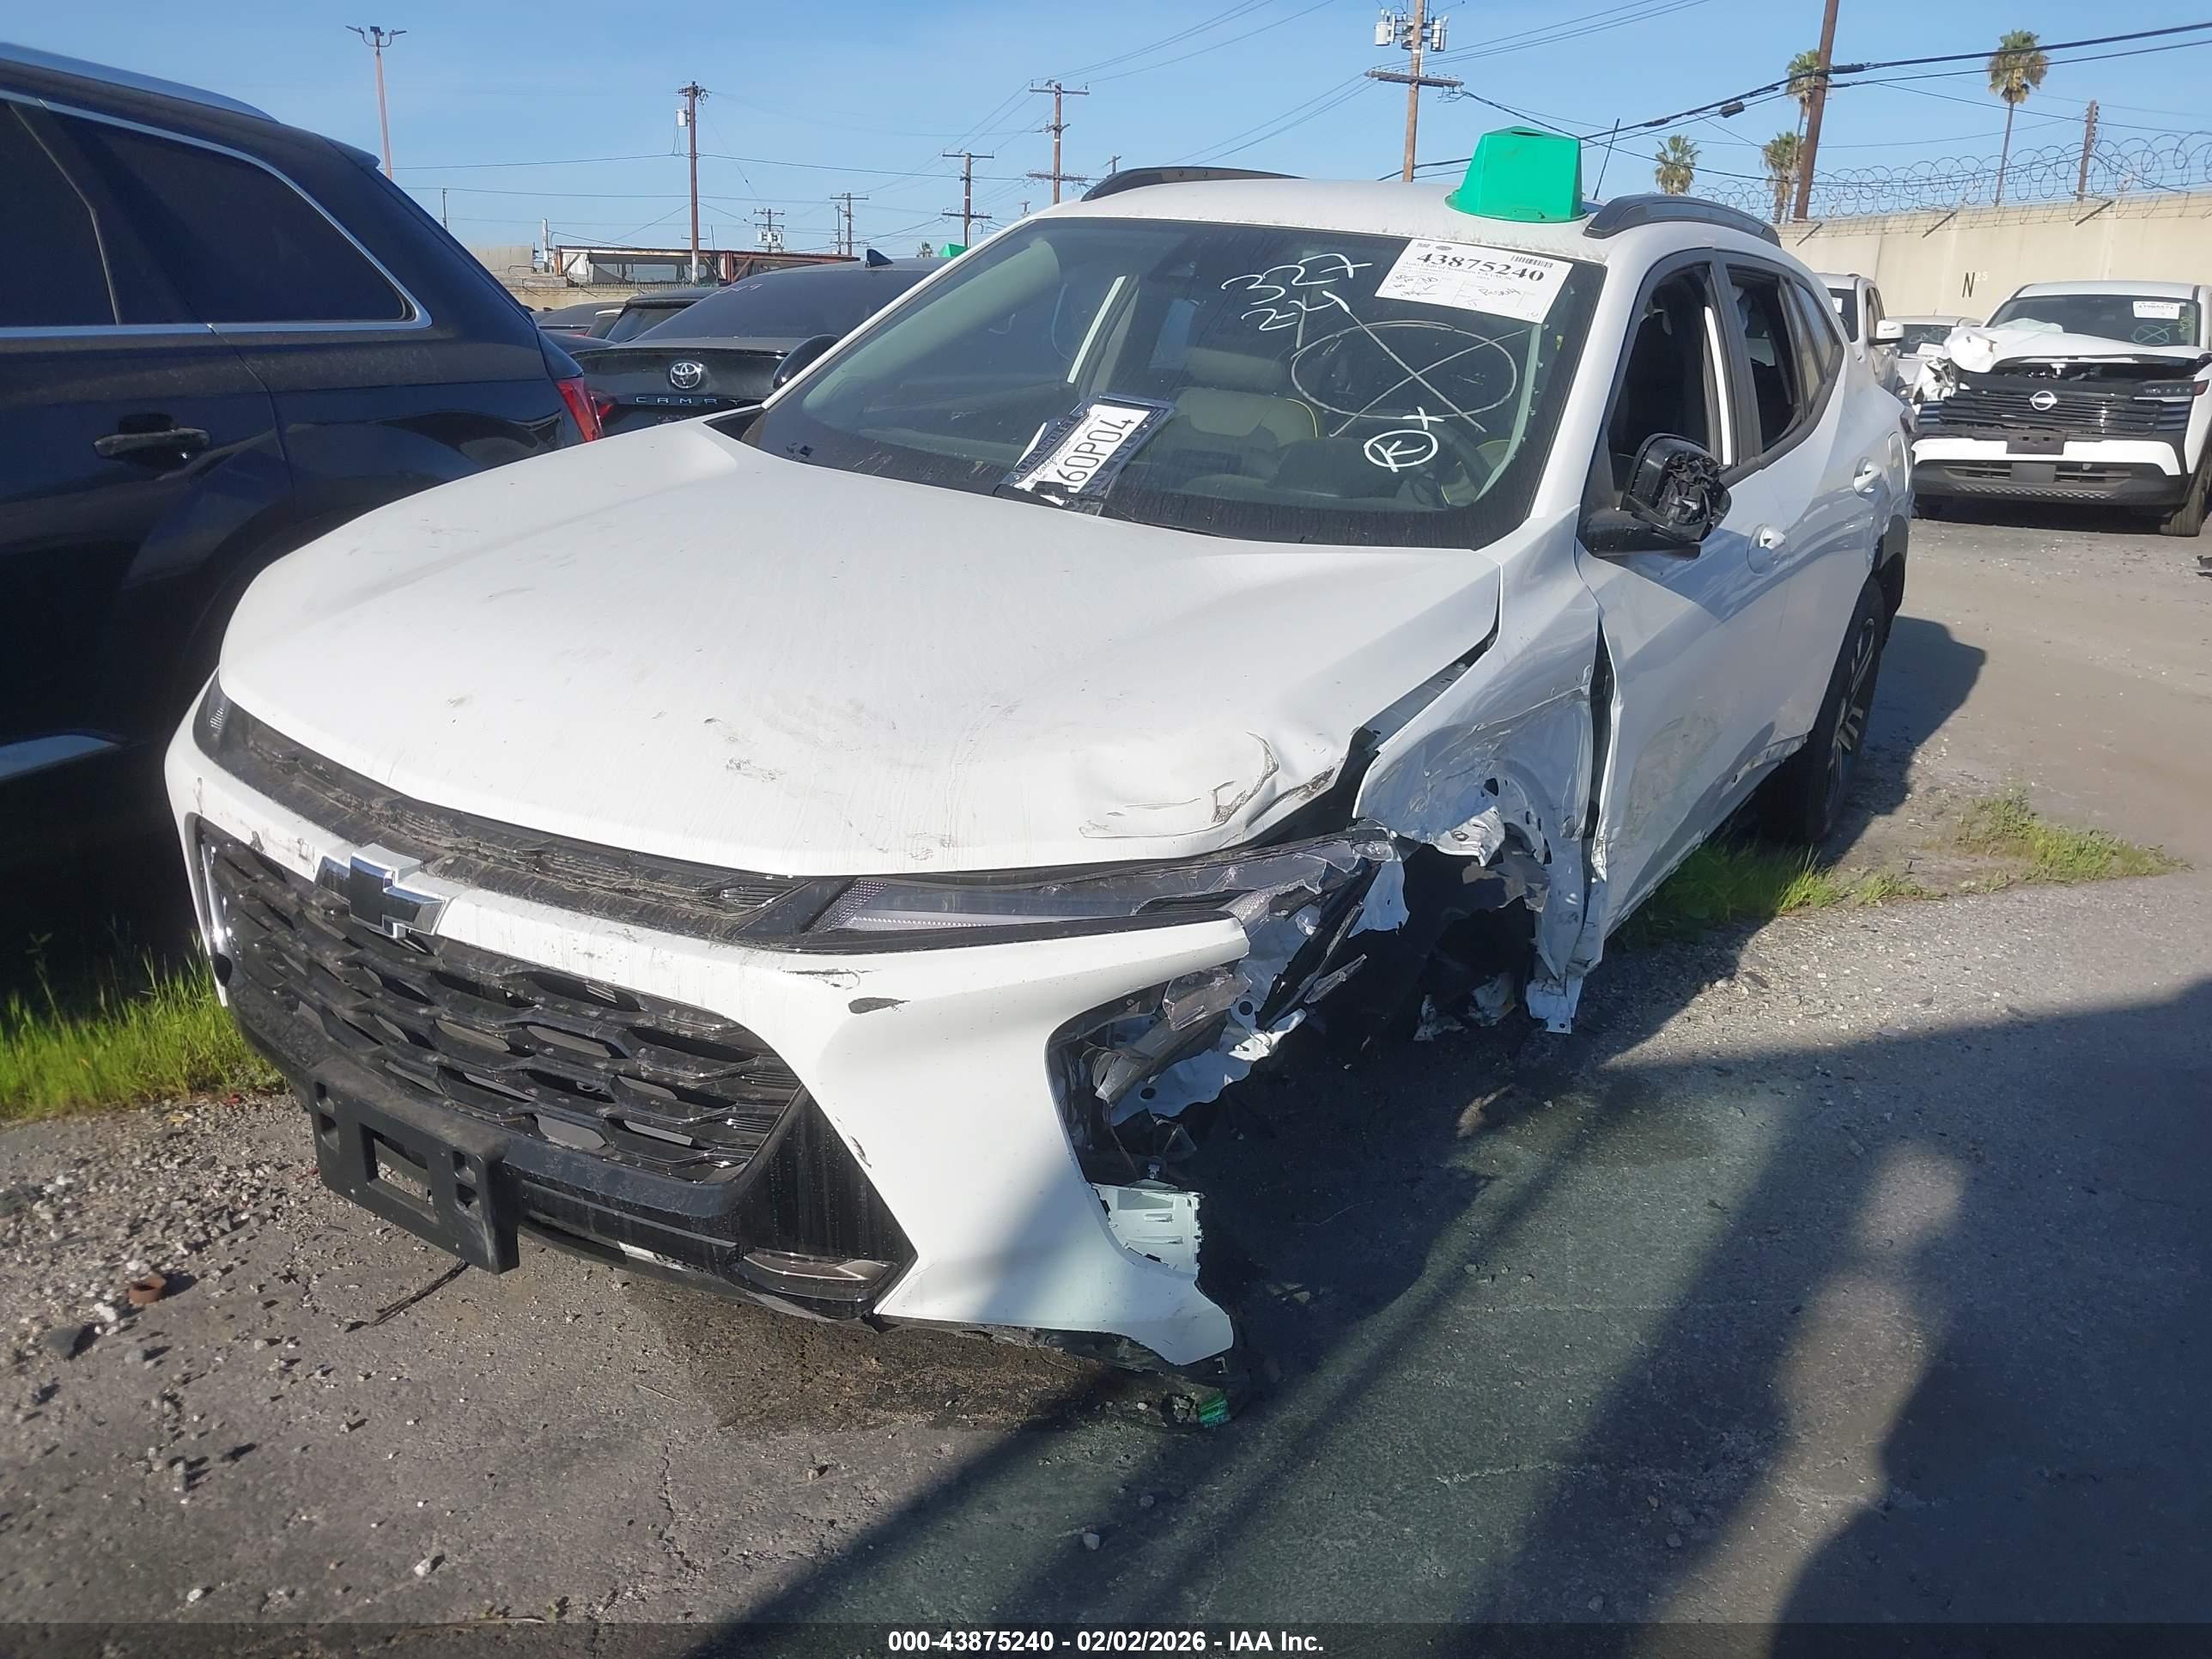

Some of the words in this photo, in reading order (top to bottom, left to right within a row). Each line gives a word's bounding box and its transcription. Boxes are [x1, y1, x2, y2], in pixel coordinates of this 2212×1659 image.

[1417, 252, 1544, 281] 43875240
[1962, 271, 1975, 298] N
[635, 397, 743, 405] CAMRY
